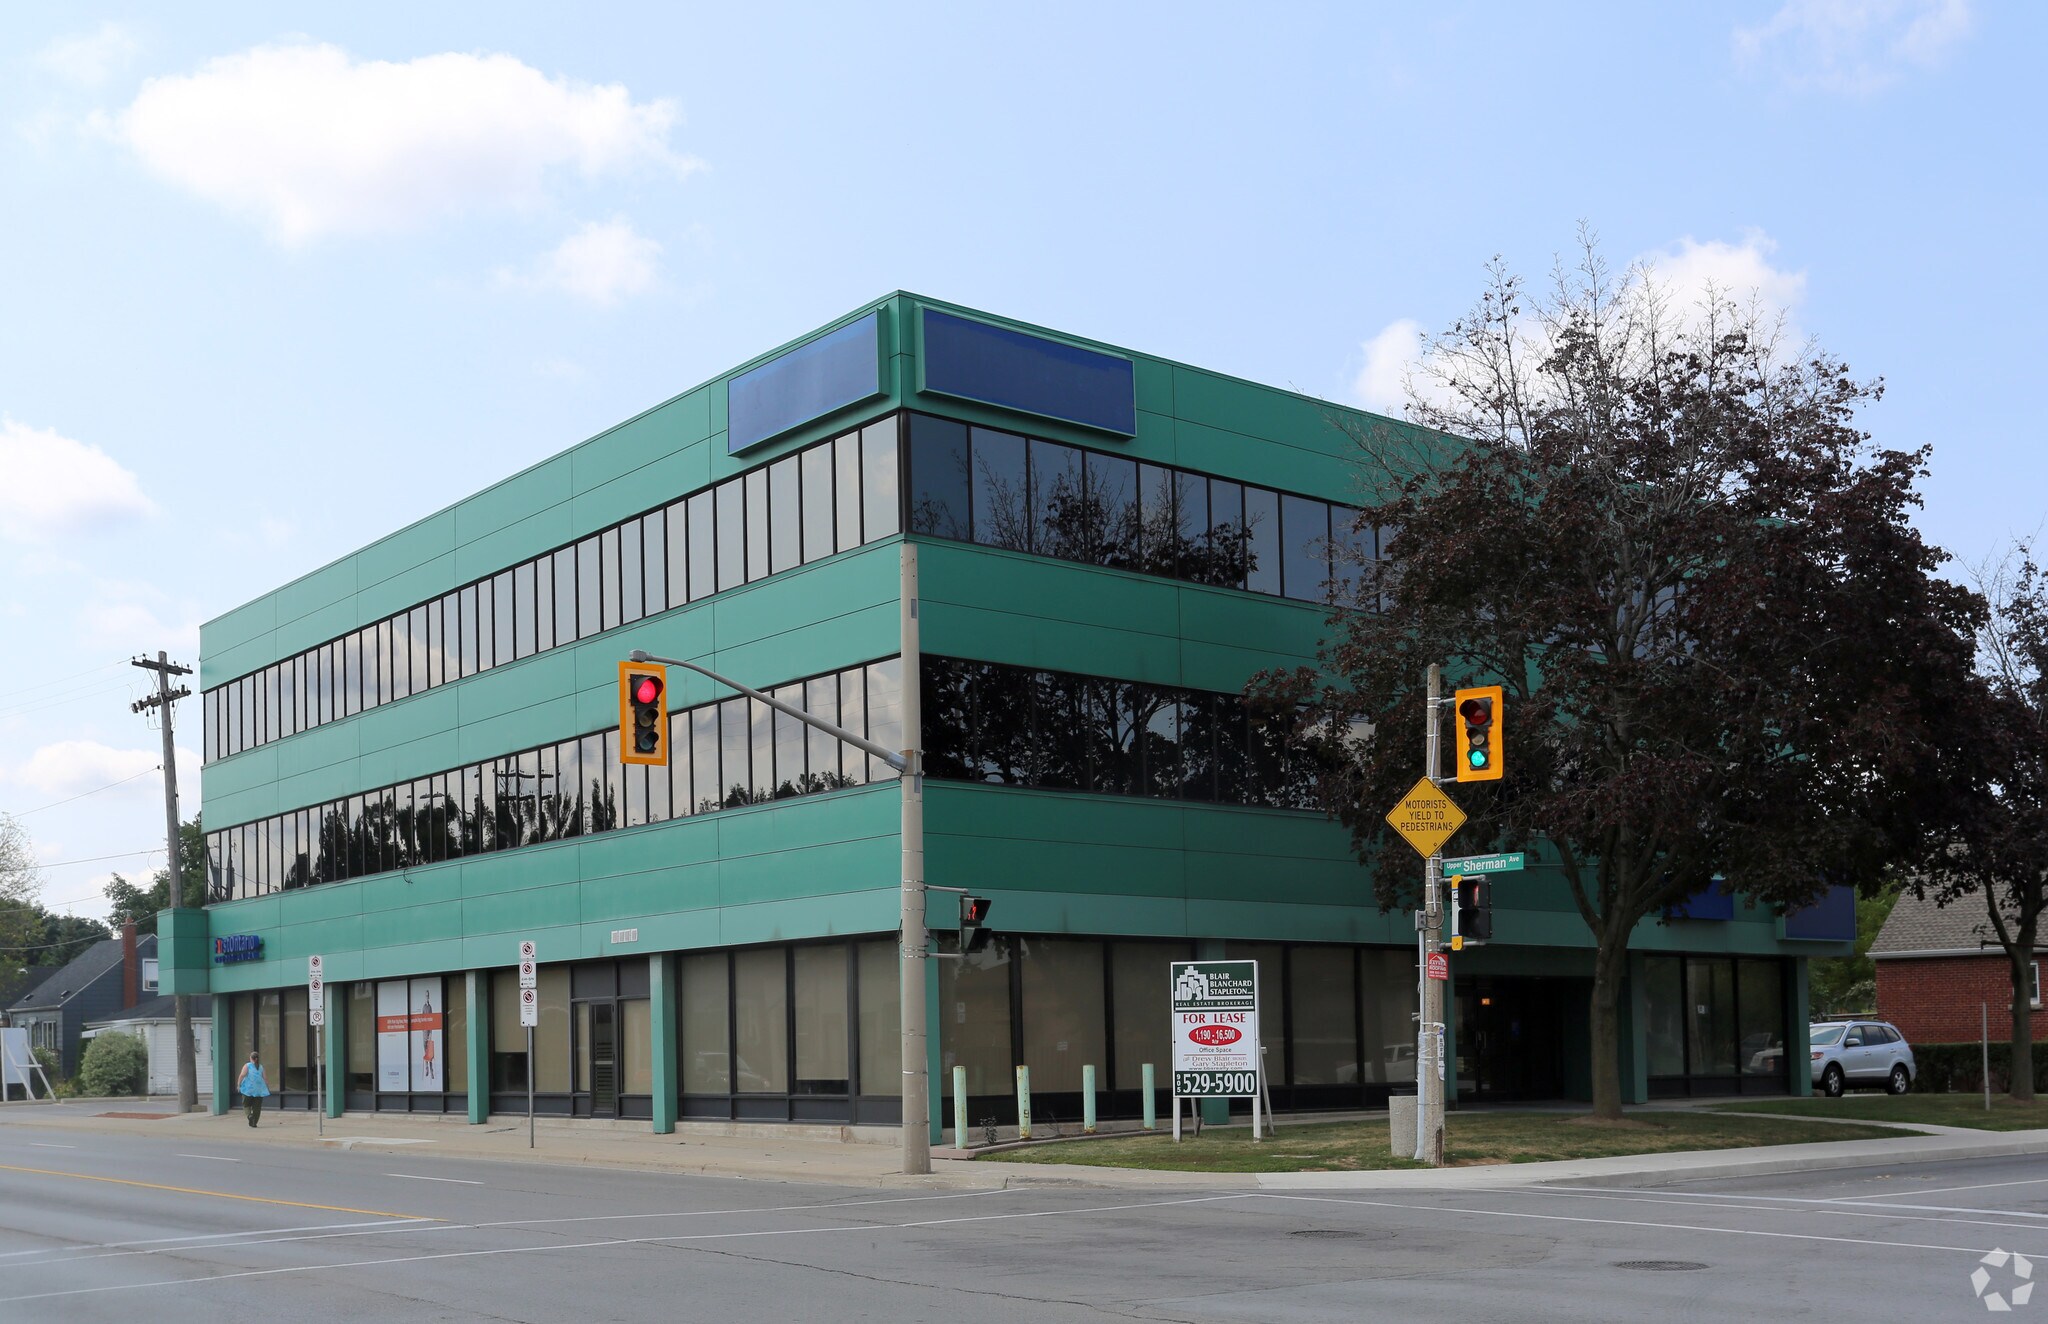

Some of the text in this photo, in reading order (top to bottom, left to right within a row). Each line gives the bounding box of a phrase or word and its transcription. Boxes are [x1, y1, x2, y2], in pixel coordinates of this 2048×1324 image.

[1405, 800, 1447, 809] MOTORISTS
[1409, 811, 1444, 820] YIELD TO
[1400, 822, 1453, 831] PEDESTRIANS
[1446, 855, 1520, 872] Upper Sherman Ave
[1183, 1012, 1246, 1024] FOR LEASE
[1195, 1029, 1211, 1041] 1,190
[1183, 1073, 1255, 1093] 529-5900
